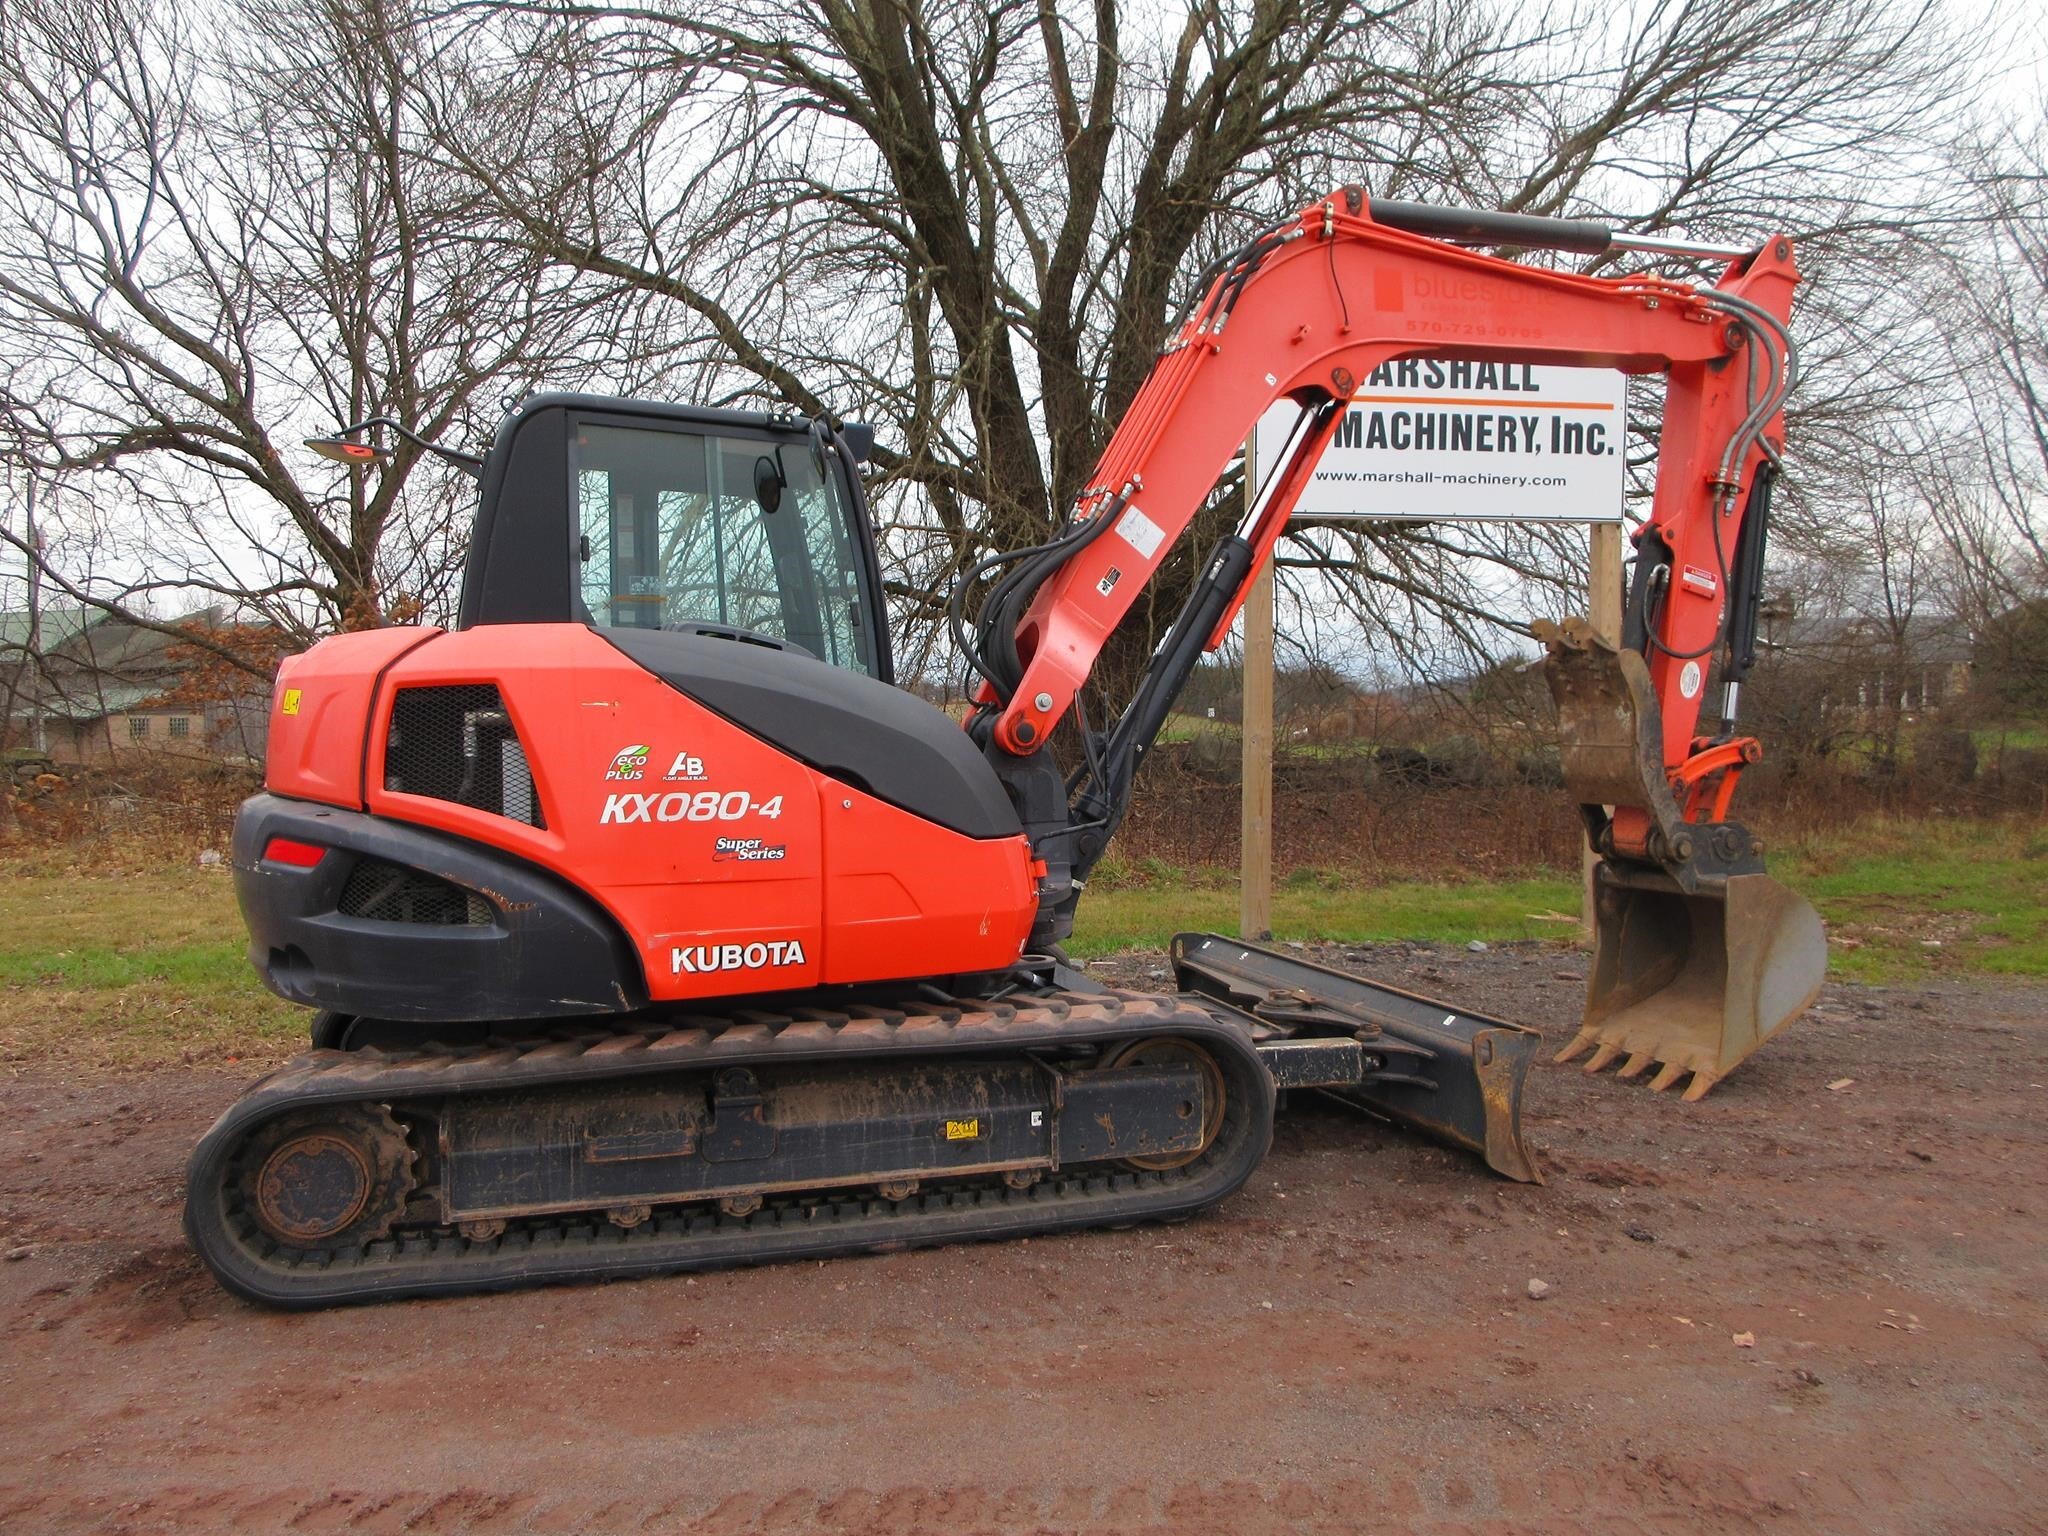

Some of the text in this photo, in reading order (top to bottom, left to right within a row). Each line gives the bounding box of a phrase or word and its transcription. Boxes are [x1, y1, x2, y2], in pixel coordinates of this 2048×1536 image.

[1361, 358, 1540, 392] ARSHALL
[1334, 411, 1614, 456] MACHINERY, Inc.
[1315, 471, 1567, 487] www.marshall-machinery.com
[617, 756, 647, 766] eco
[605, 770, 644, 780] PLUS
[599, 791, 784, 824] KX080-4
[715, 837, 762, 851] Super
[738, 848, 785, 860] Series
[671, 940, 805, 974] KUBOTA
